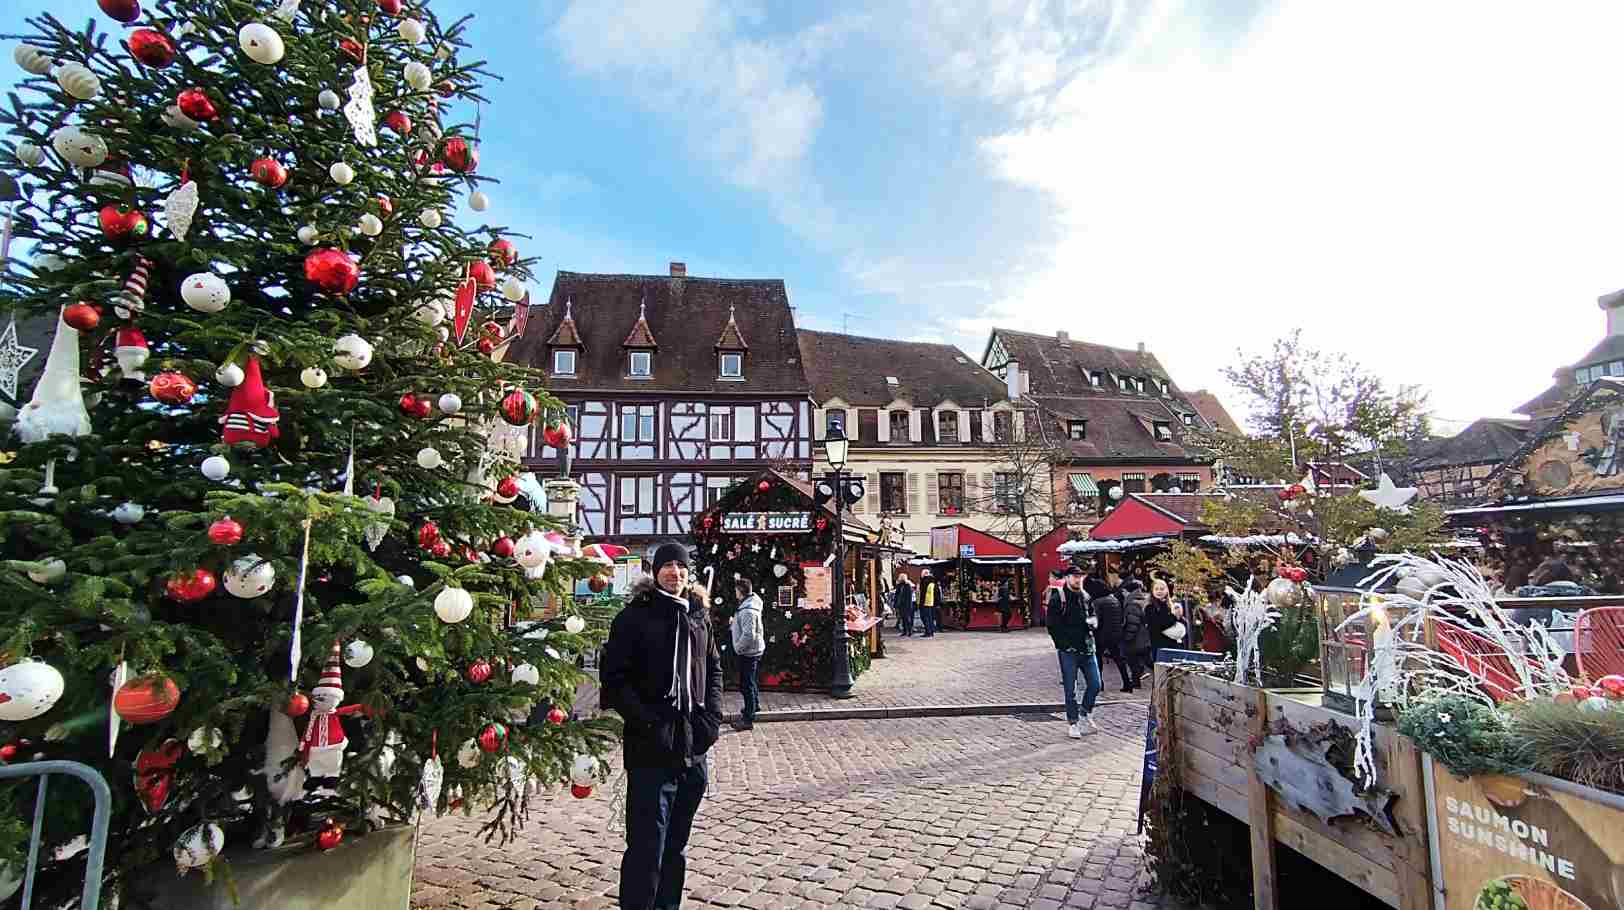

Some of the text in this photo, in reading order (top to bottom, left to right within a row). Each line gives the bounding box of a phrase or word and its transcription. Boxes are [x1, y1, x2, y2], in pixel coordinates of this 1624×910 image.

[724, 514, 809, 528] SALÉ SUCRÉ
[1446, 797, 1548, 847] SAUMON
[1447, 817, 1576, 880] SUNSHINE
